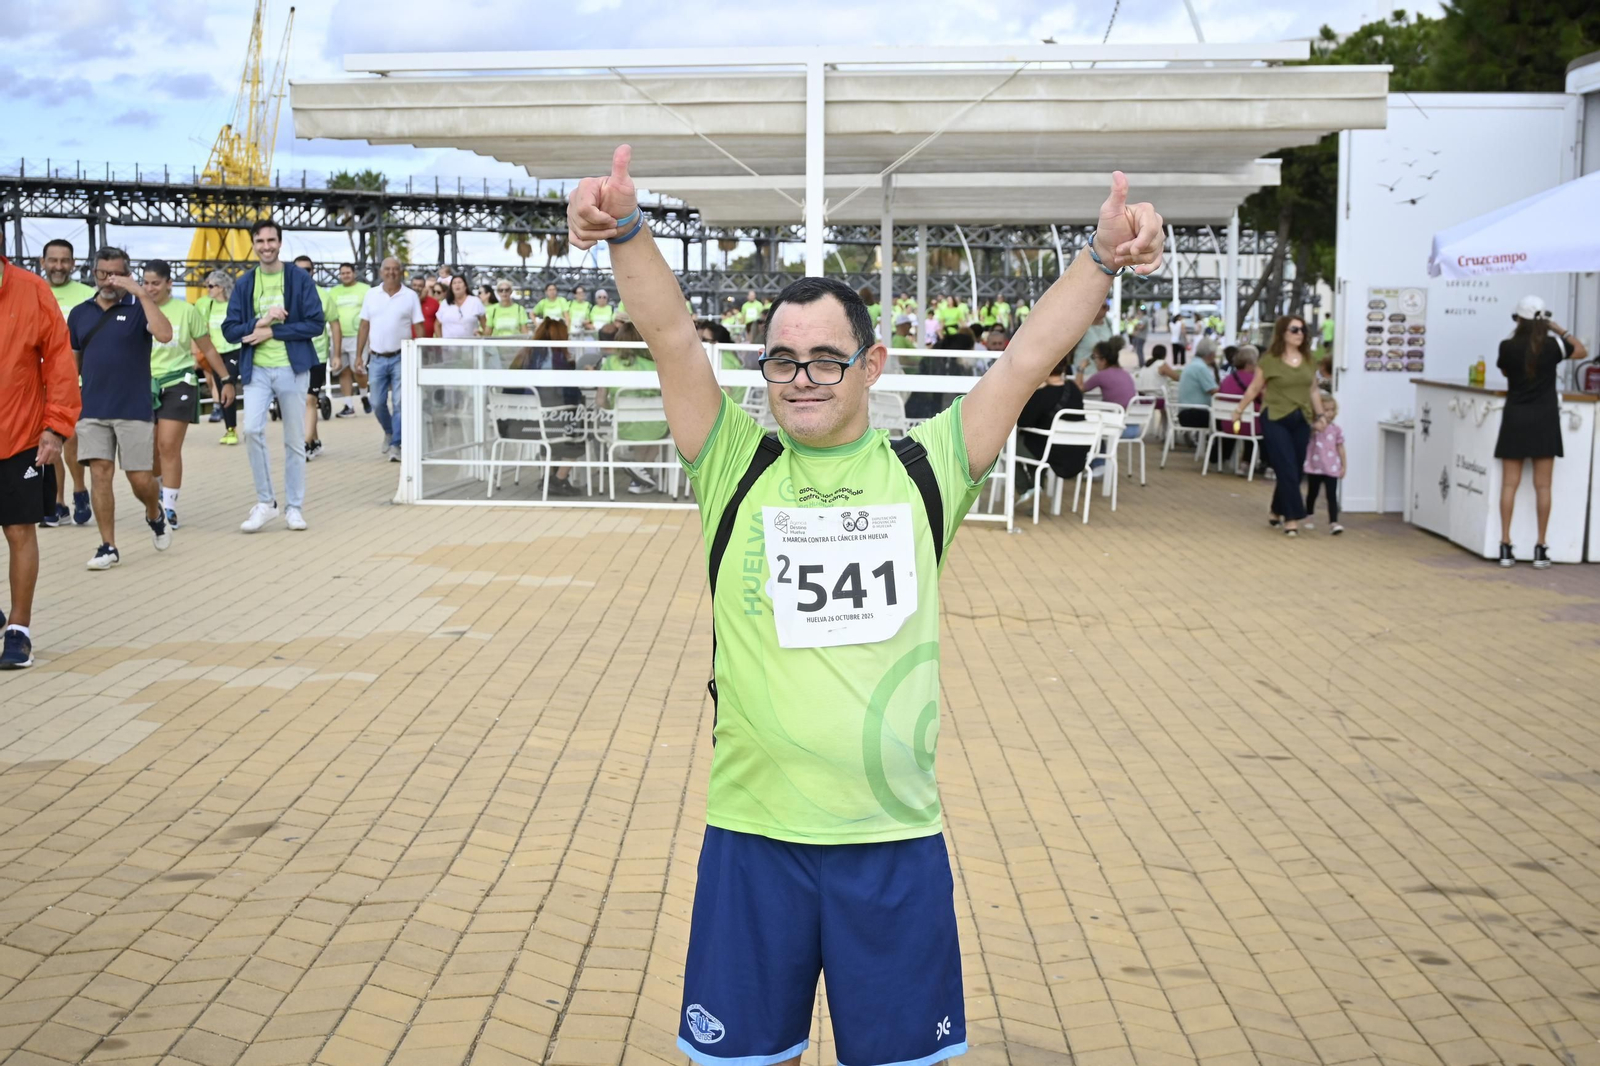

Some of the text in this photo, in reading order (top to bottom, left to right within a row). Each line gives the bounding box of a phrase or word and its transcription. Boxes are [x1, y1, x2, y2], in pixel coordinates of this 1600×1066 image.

[1457, 252, 1527, 267] Cruzcampo
[837, 533, 858, 542] CÁNCER
[806, 612, 874, 623] HUELVA 26 OCTUBRE 2025
